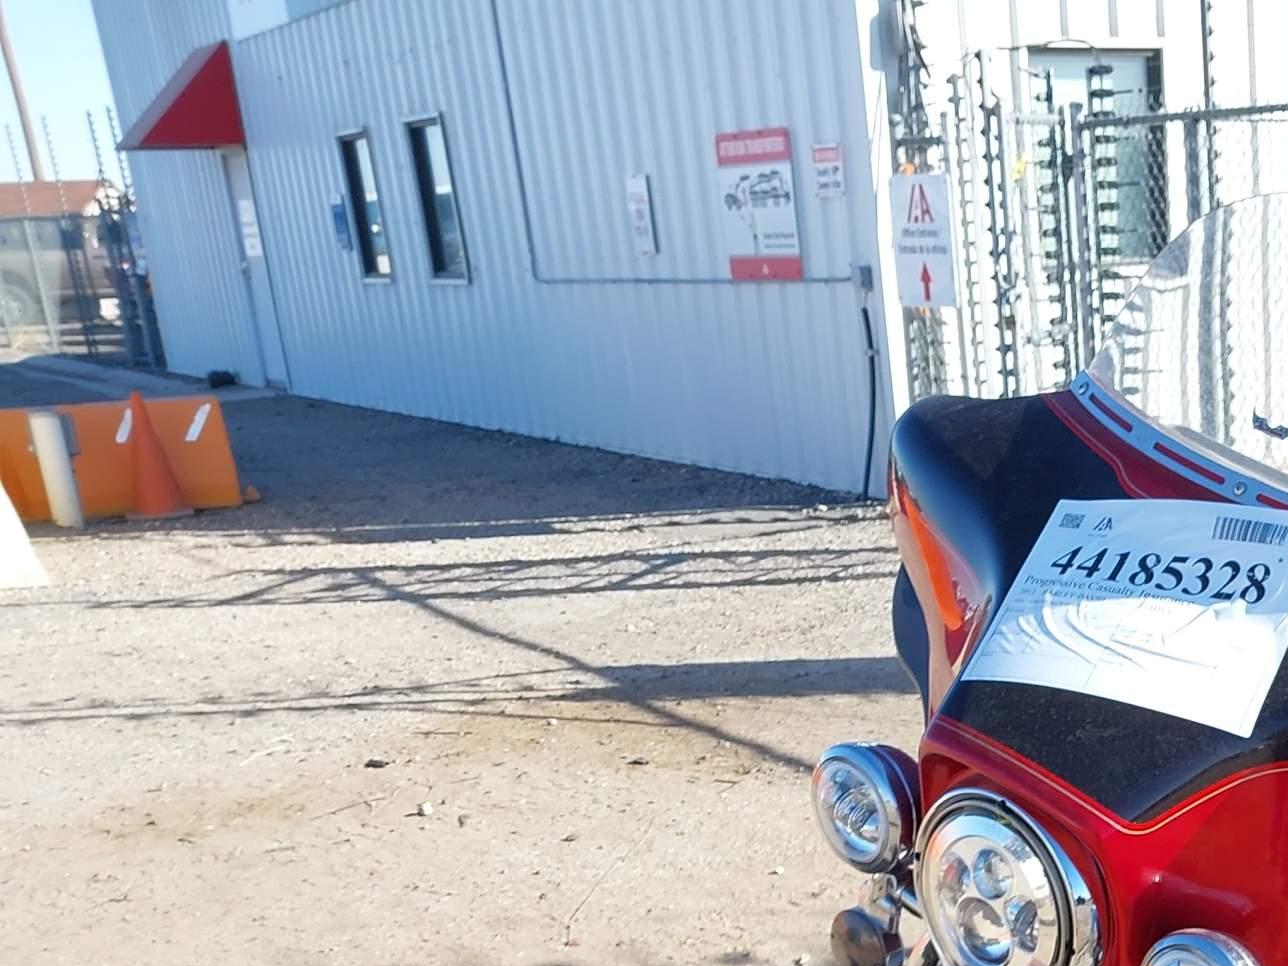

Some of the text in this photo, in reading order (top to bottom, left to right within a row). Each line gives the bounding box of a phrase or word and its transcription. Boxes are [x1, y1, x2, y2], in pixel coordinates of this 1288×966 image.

[1024, 575, 1085, 589] Progressive
[1088, 582, 1134, 598] Casualty
[1051, 546, 1271, 605] 44185328
